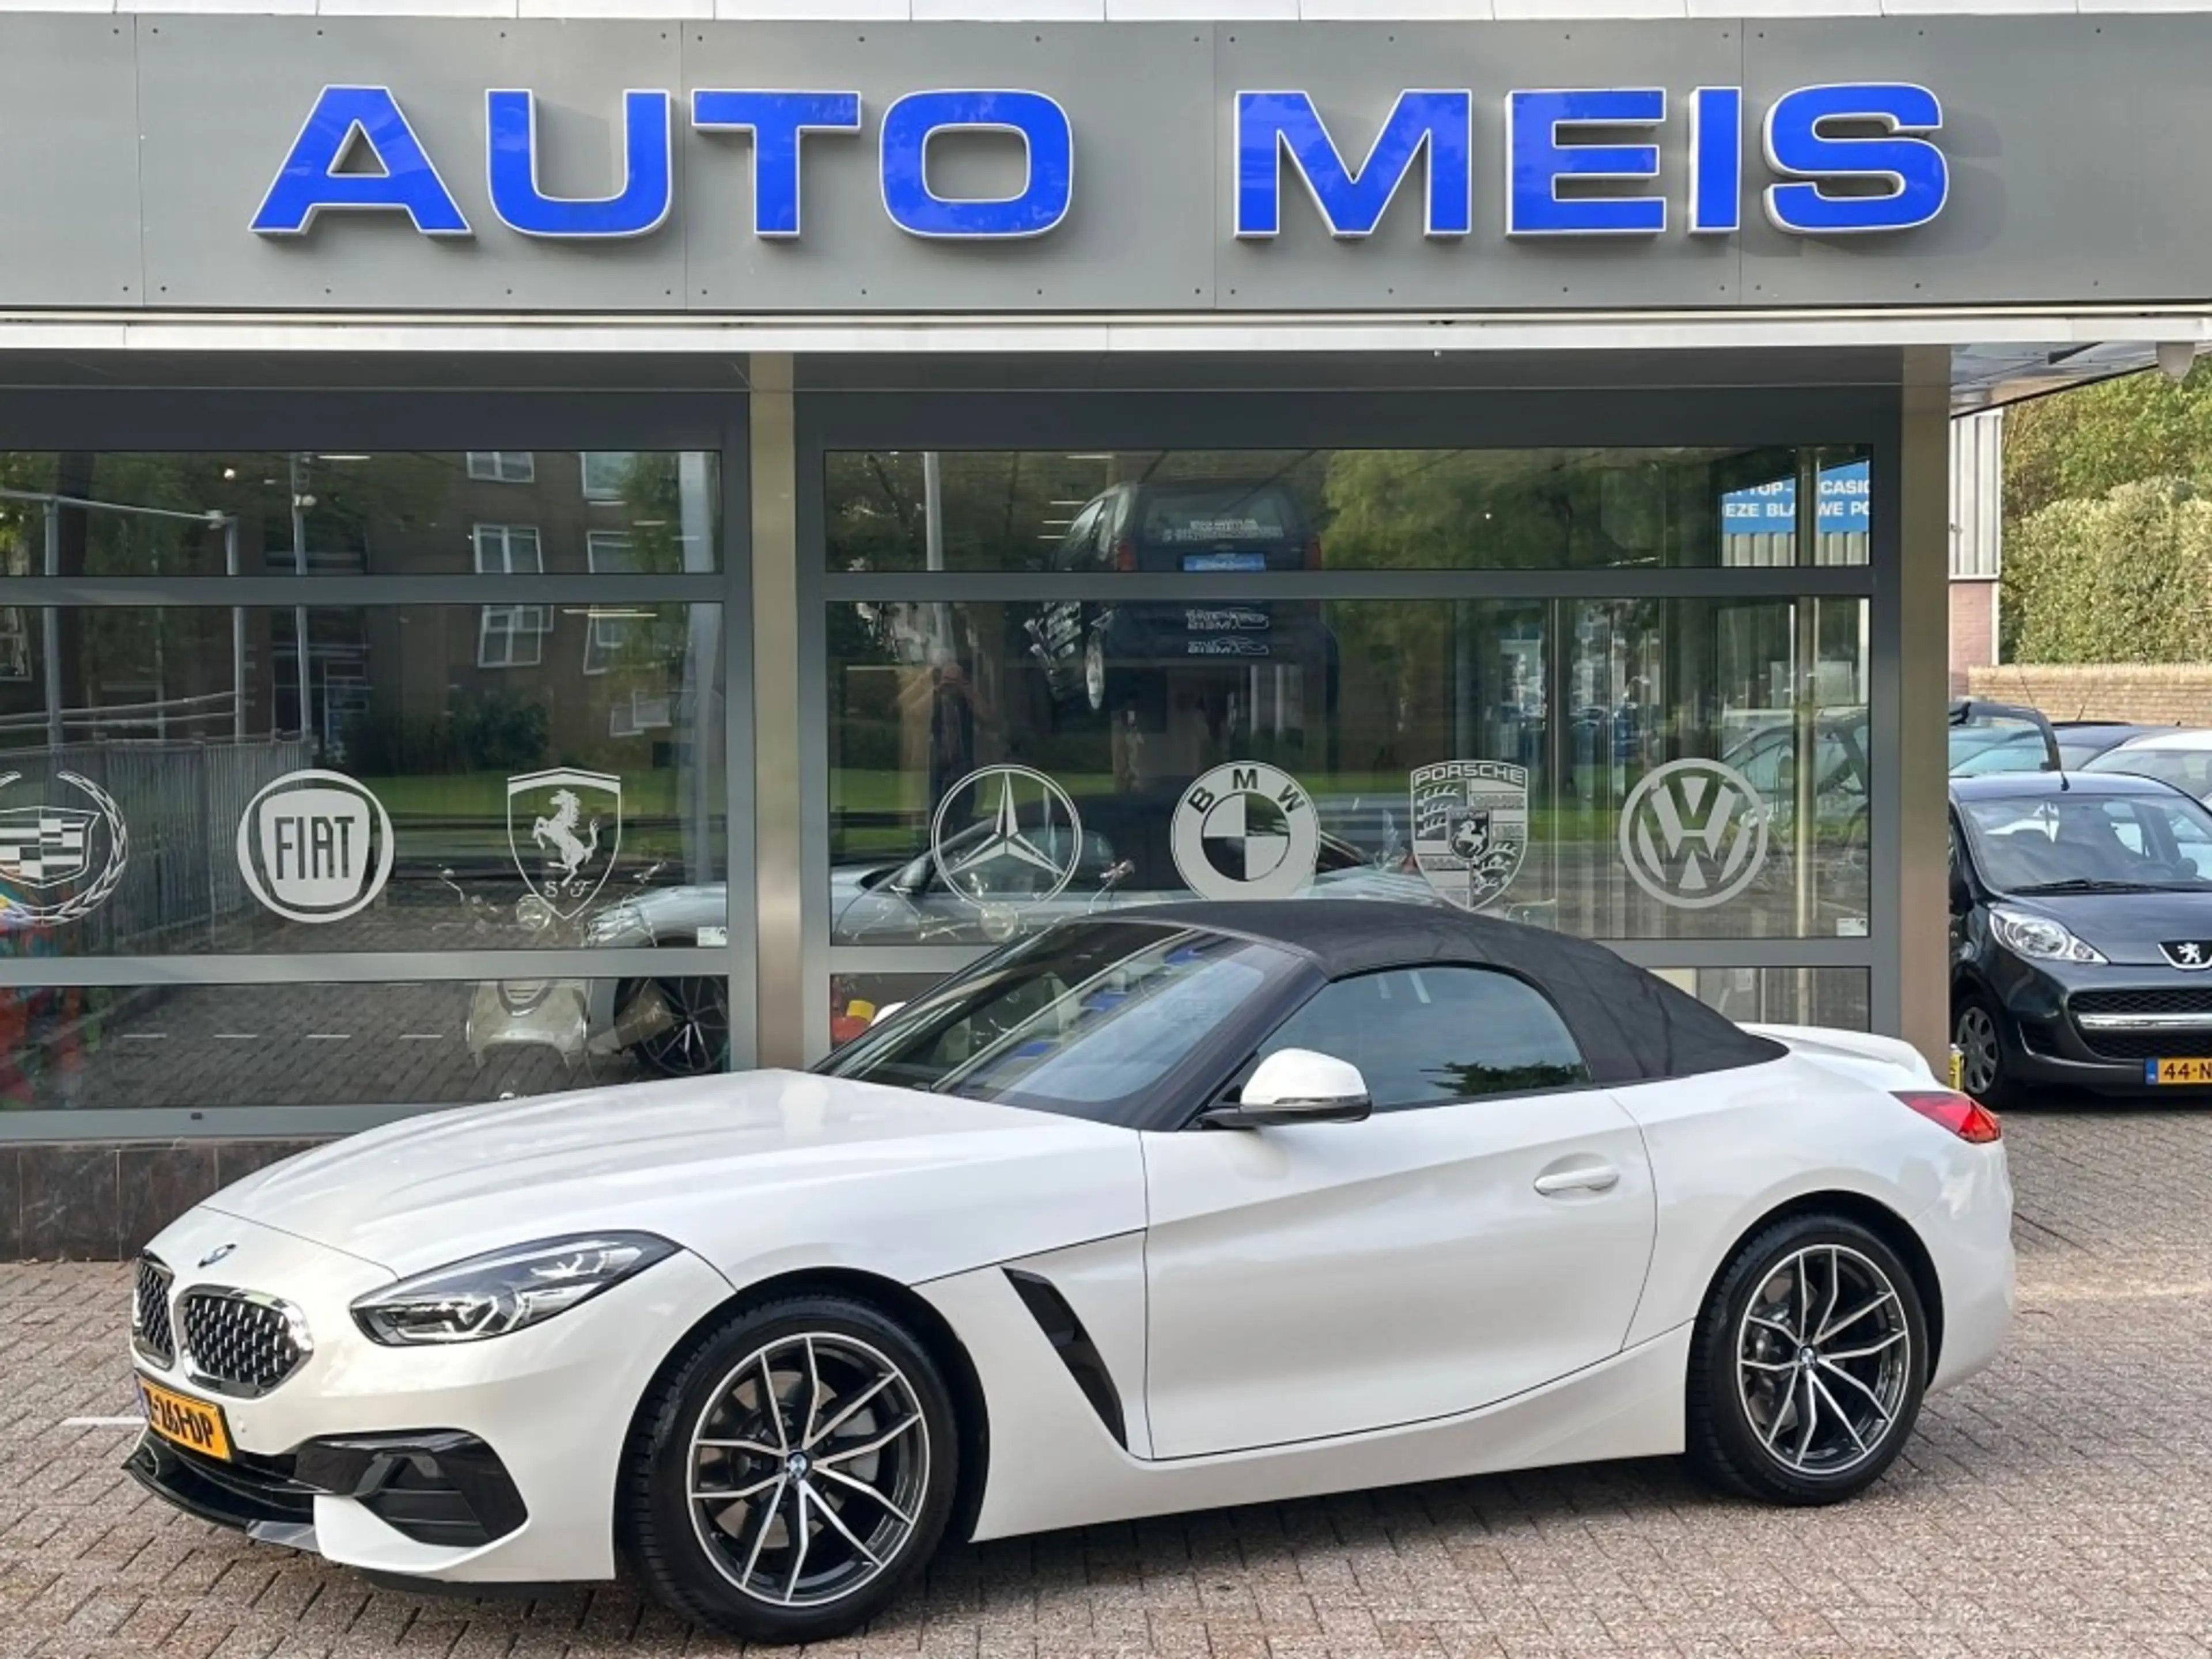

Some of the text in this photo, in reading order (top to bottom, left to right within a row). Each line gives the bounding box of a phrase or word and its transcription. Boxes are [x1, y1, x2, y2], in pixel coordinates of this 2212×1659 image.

[248, 81, 1949, 237] AUTO MEIS
[1188, 768, 1306, 815] BMW
[1415, 764, 1524, 787] PORSCHE
[274, 816, 355, 880] FIAT
